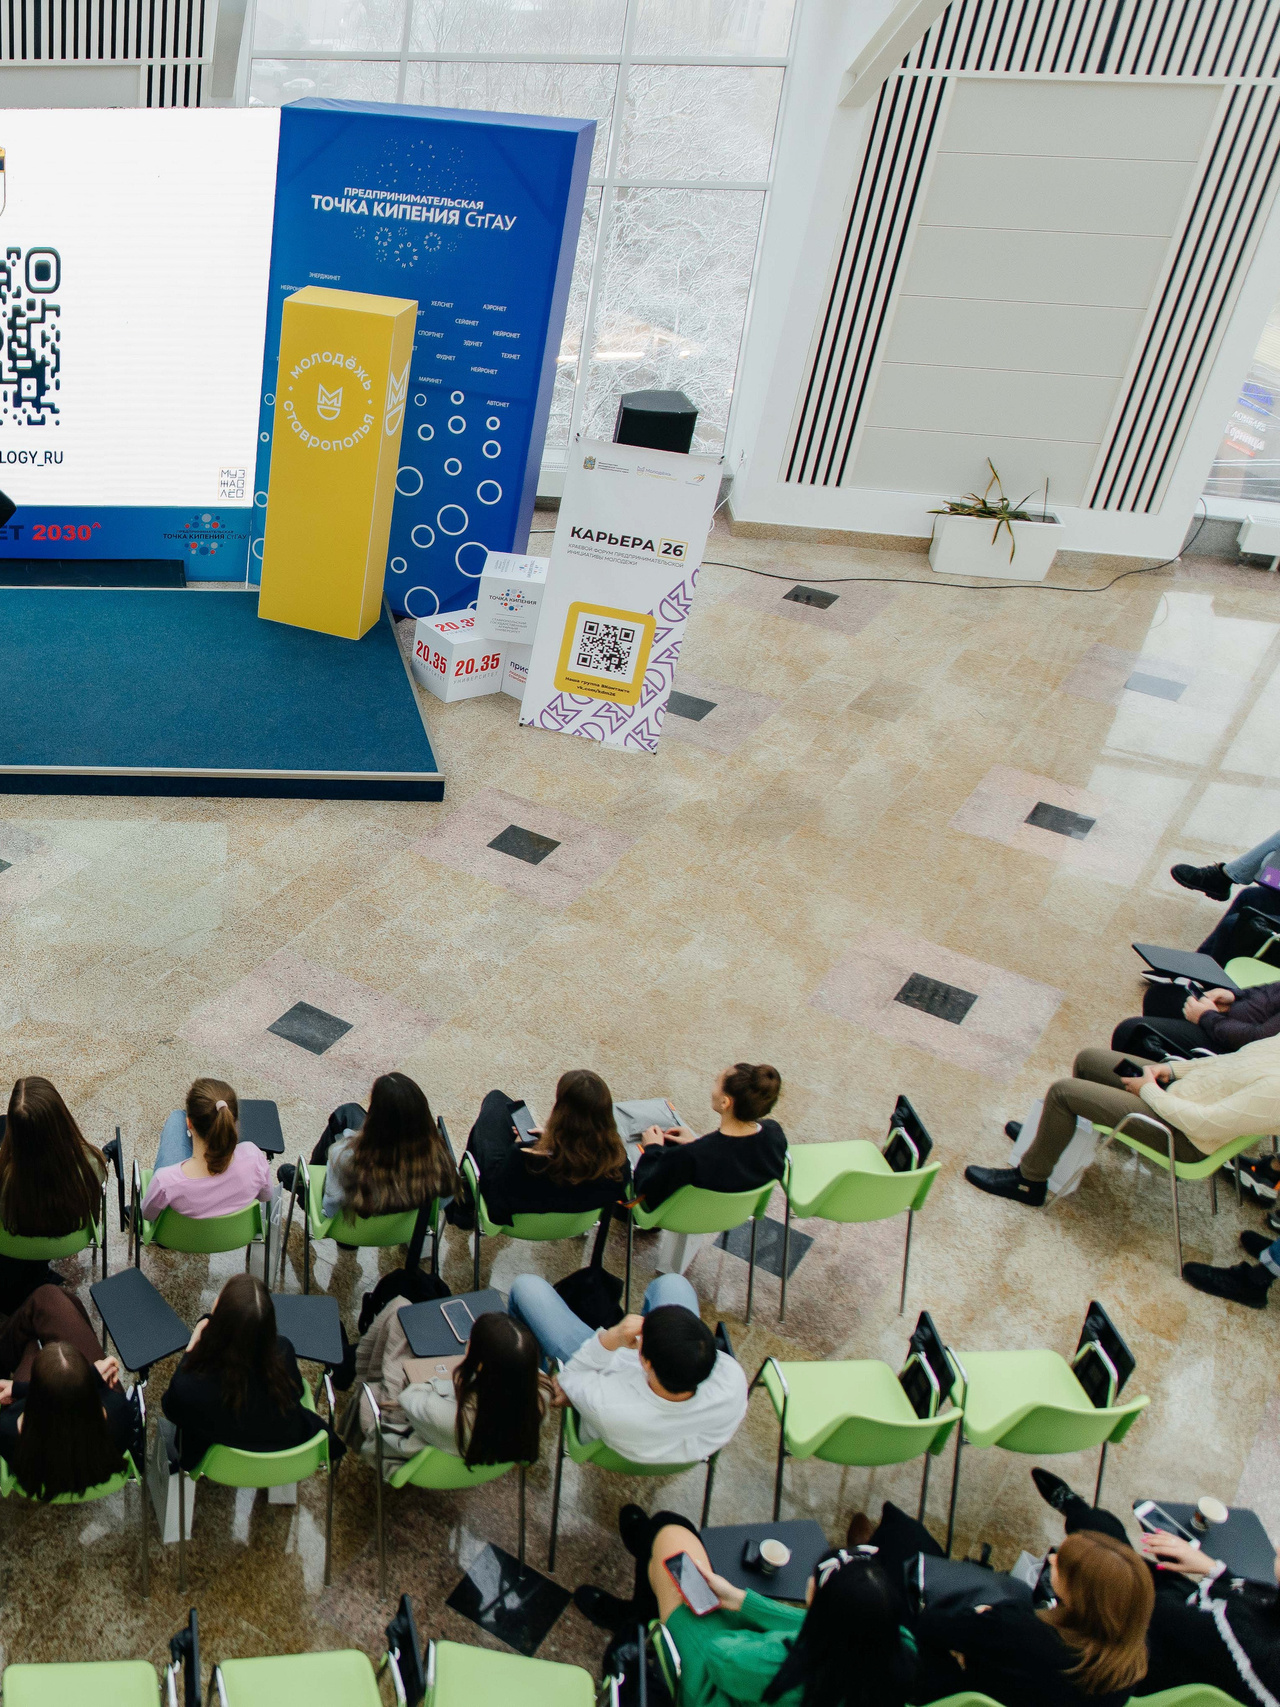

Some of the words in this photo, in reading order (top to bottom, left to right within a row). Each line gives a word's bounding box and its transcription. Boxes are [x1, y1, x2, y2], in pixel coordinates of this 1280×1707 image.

[344, 187, 484, 210] ПРЕДПРИНИМАТЕЛЬСКАЯ
[311, 194, 368, 216] ТОЧКА
[373, 201, 460, 225] КИПЕНИЯ
[465, 211, 517, 231] СтГАУ
[482, 304, 507, 312] АЭРОНЕТ
[418, 330, 444, 339] СПОРТНЕТ
[492, 330, 521, 339] НЕЙРОНЕТ
[470, 366, 498, 376] НЕЙРОНЕТ
[418, 376, 442, 384] МАРИНЕТ
[486, 400, 510, 408] АВТОНЕТ
[570, 526, 655, 552] КАРЬЕРА
[661, 542, 684, 557] 26
[568, 543, 593, 552] КРАЕВОЙ
[594, 548, 614, 556] ФОРУМ
[566, 550, 604, 560] ИНИЦИАТИВЫ
[489, 594, 508, 602] ТОЧКА
[416, 640, 448, 674] 20.35
[454, 652, 502, 678] 20.35
[510, 660, 529, 674] прис
[453, 671, 499, 684] УНИВЕРСИТЕТ
[580, 680, 600, 688] группа
